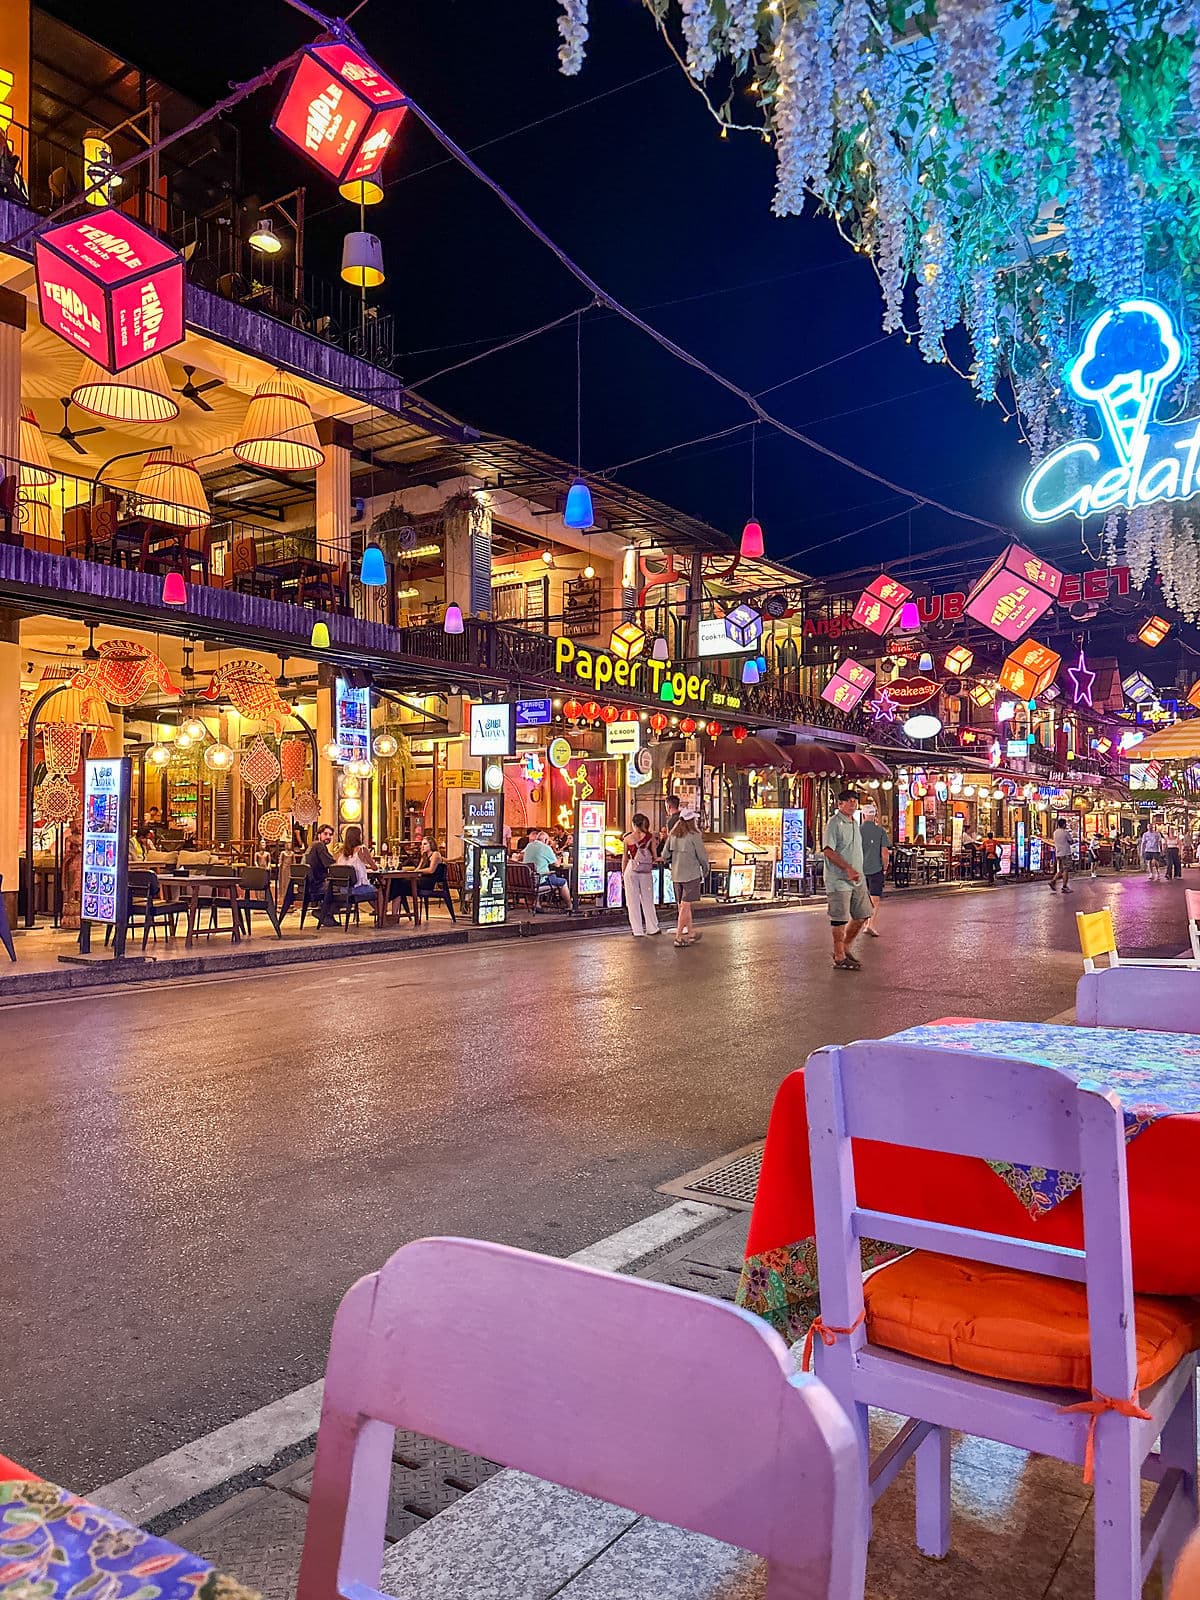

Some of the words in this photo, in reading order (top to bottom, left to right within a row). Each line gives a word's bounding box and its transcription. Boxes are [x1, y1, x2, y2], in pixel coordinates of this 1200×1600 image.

[305, 83, 343, 151] TEMPLE
[76, 224, 143, 269] TEMPLE
[84, 241, 110, 260] Club
[43, 281, 101, 333] TEMPLE
[61, 308, 85, 331] Club
[133, 308, 141, 337] Club
[141, 281, 164, 352] TEMPLE
[1024, 422, 1200, 518] Gelat
[917, 592, 967, 622] UB
[990, 586, 1030, 626] TEMPLE
[555, 637, 641, 691] Paper
[647, 658, 710, 706] Tiger
[469, 804, 495, 817] Robam
